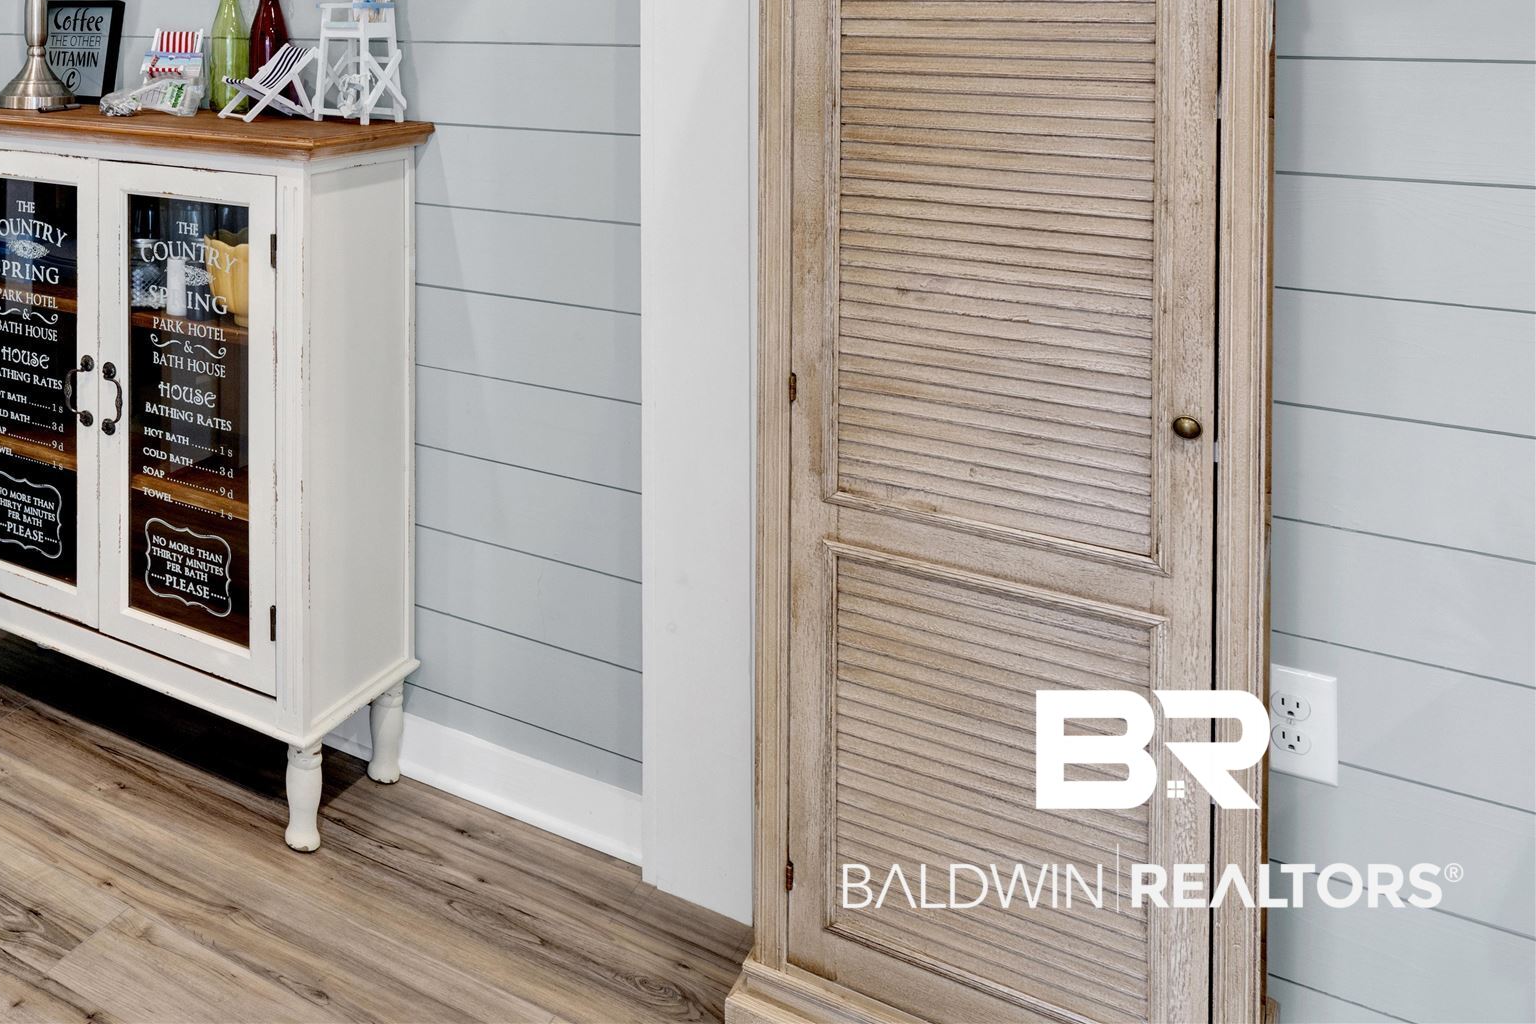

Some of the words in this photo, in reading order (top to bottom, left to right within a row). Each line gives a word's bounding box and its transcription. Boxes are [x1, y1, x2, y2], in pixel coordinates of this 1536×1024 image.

[54, 7, 104, 32] Coffee
[51, 35, 68, 47] THE
[70, 36, 101, 47] OTHER
[49, 51, 100, 68] VITAMIN
[66, 71, 76, 88] C
[16, 200, 35, 214] THE
[176, 220, 199, 237] THE
[140, 240, 239, 274] COUNTRY
[25, 293, 58, 309] HOTEL
[22, 308, 31, 320] &
[25, 325, 58, 342] HOUSE
[152, 316, 185, 335] PARK
[188, 322, 227, 342] HOTEL
[183, 340, 194, 354] &
[152, 351, 185, 370] BATH
[187, 358, 226, 378] HOUSE
[33, 374, 63, 390] RATES
[7, 392, 27, 404] BATH
[10, 412, 31, 424] BATH
[145, 401, 194, 423] BATHING
[196, 414, 232, 432] RATES
[143, 426, 164, 438] HOT
[165, 432, 190, 446] BATH
[143, 447, 167, 460] COLD
[169, 453, 194, 468] BATH
[142, 465, 165, 479] SOAP
[9, 490, 31, 503] MORE
[33, 497, 55, 511] THAN
[142, 486, 173, 503] TOWEL
[23, 514, 43, 528] BATH
[24, 505, 56, 522] MINUTES
[6, 521, 44, 543] PLEASE
[152, 534, 166, 546] NO
[168, 540, 195, 555] MORE
[197, 548, 223, 564] THAN
[152, 546, 183, 564] THIRTY
[186, 557, 224, 577] MINUTES
[184, 567, 208, 582] BATH
[165, 574, 210, 599] PLEASE
